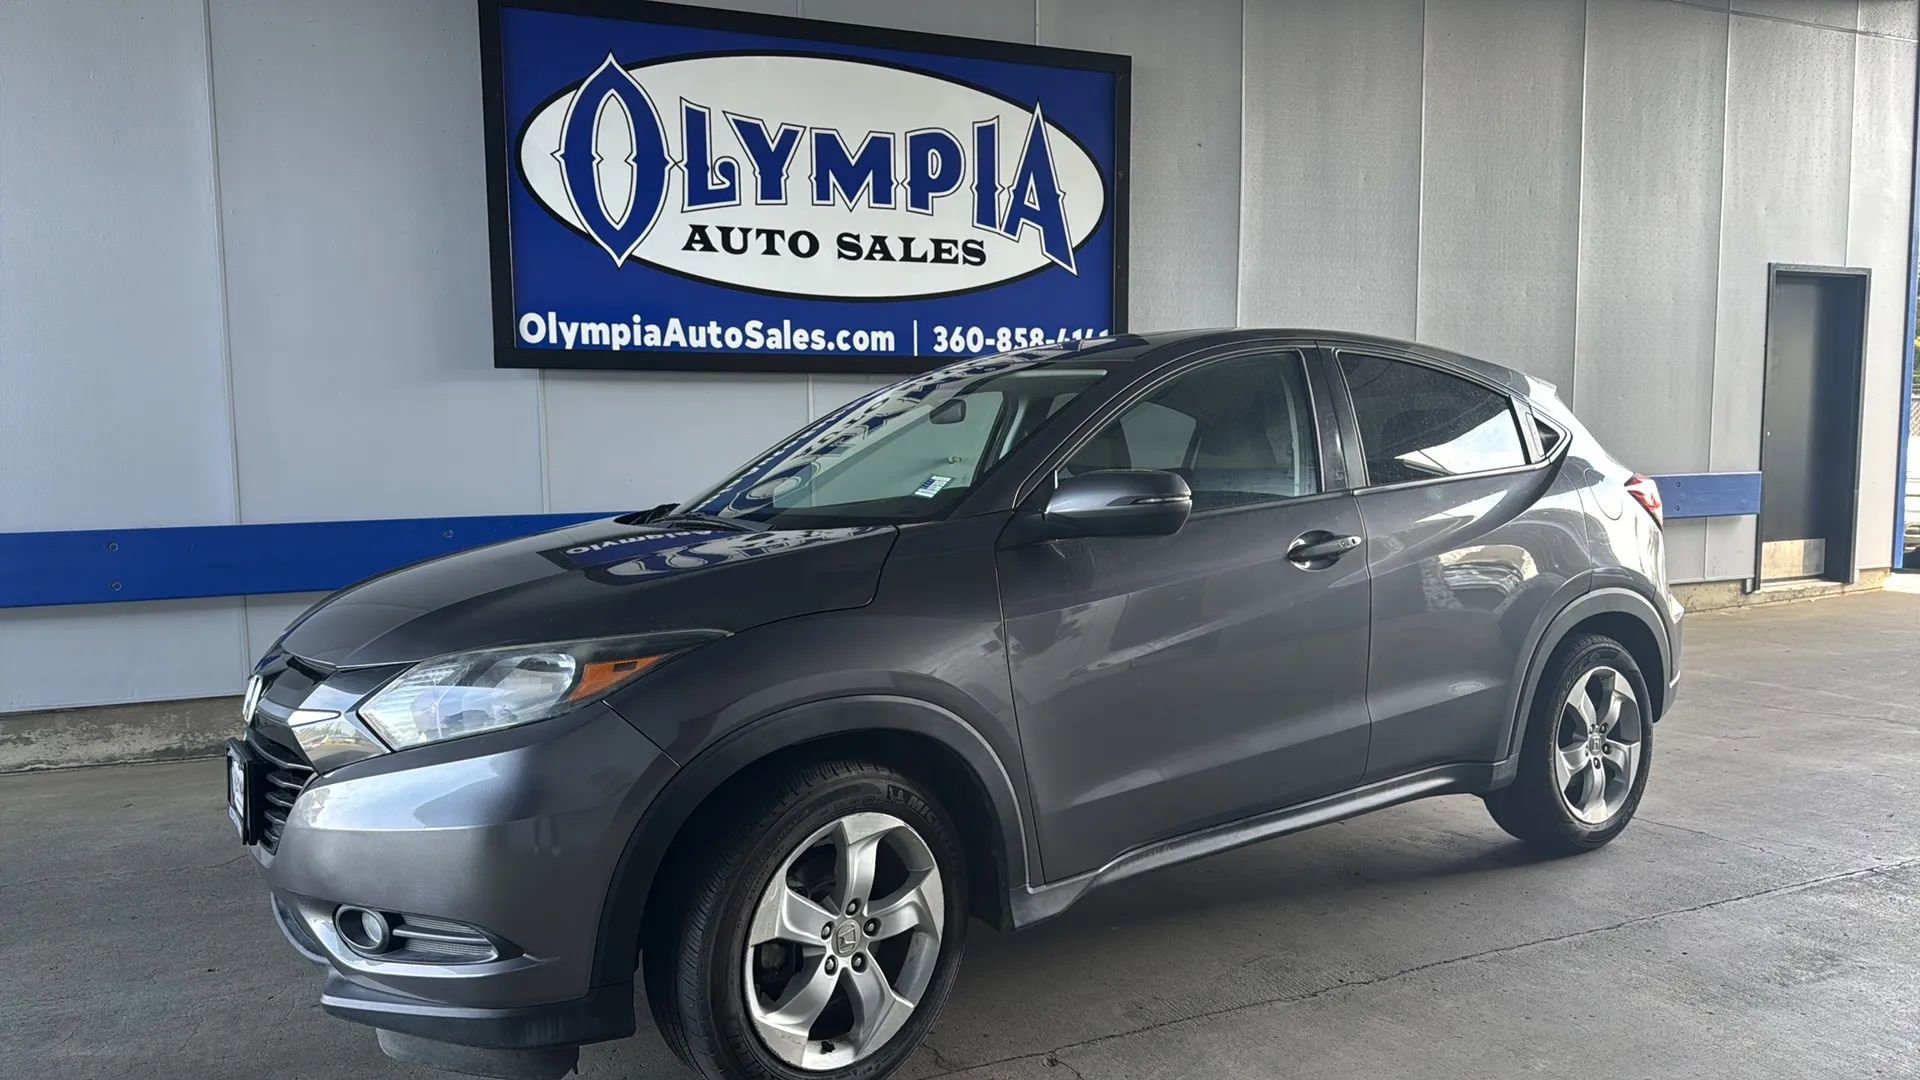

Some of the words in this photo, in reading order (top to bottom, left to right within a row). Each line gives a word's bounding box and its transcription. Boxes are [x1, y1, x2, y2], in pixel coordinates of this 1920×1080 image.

[552, 50, 1078, 276] OLYMPIA
[681, 224, 820, 259] AUTO
[836, 232, 986, 266] SALES
[518, 311, 895, 351] OlympiaAutoSales.com
[933, 325, 1109, 353] 360-858-4
